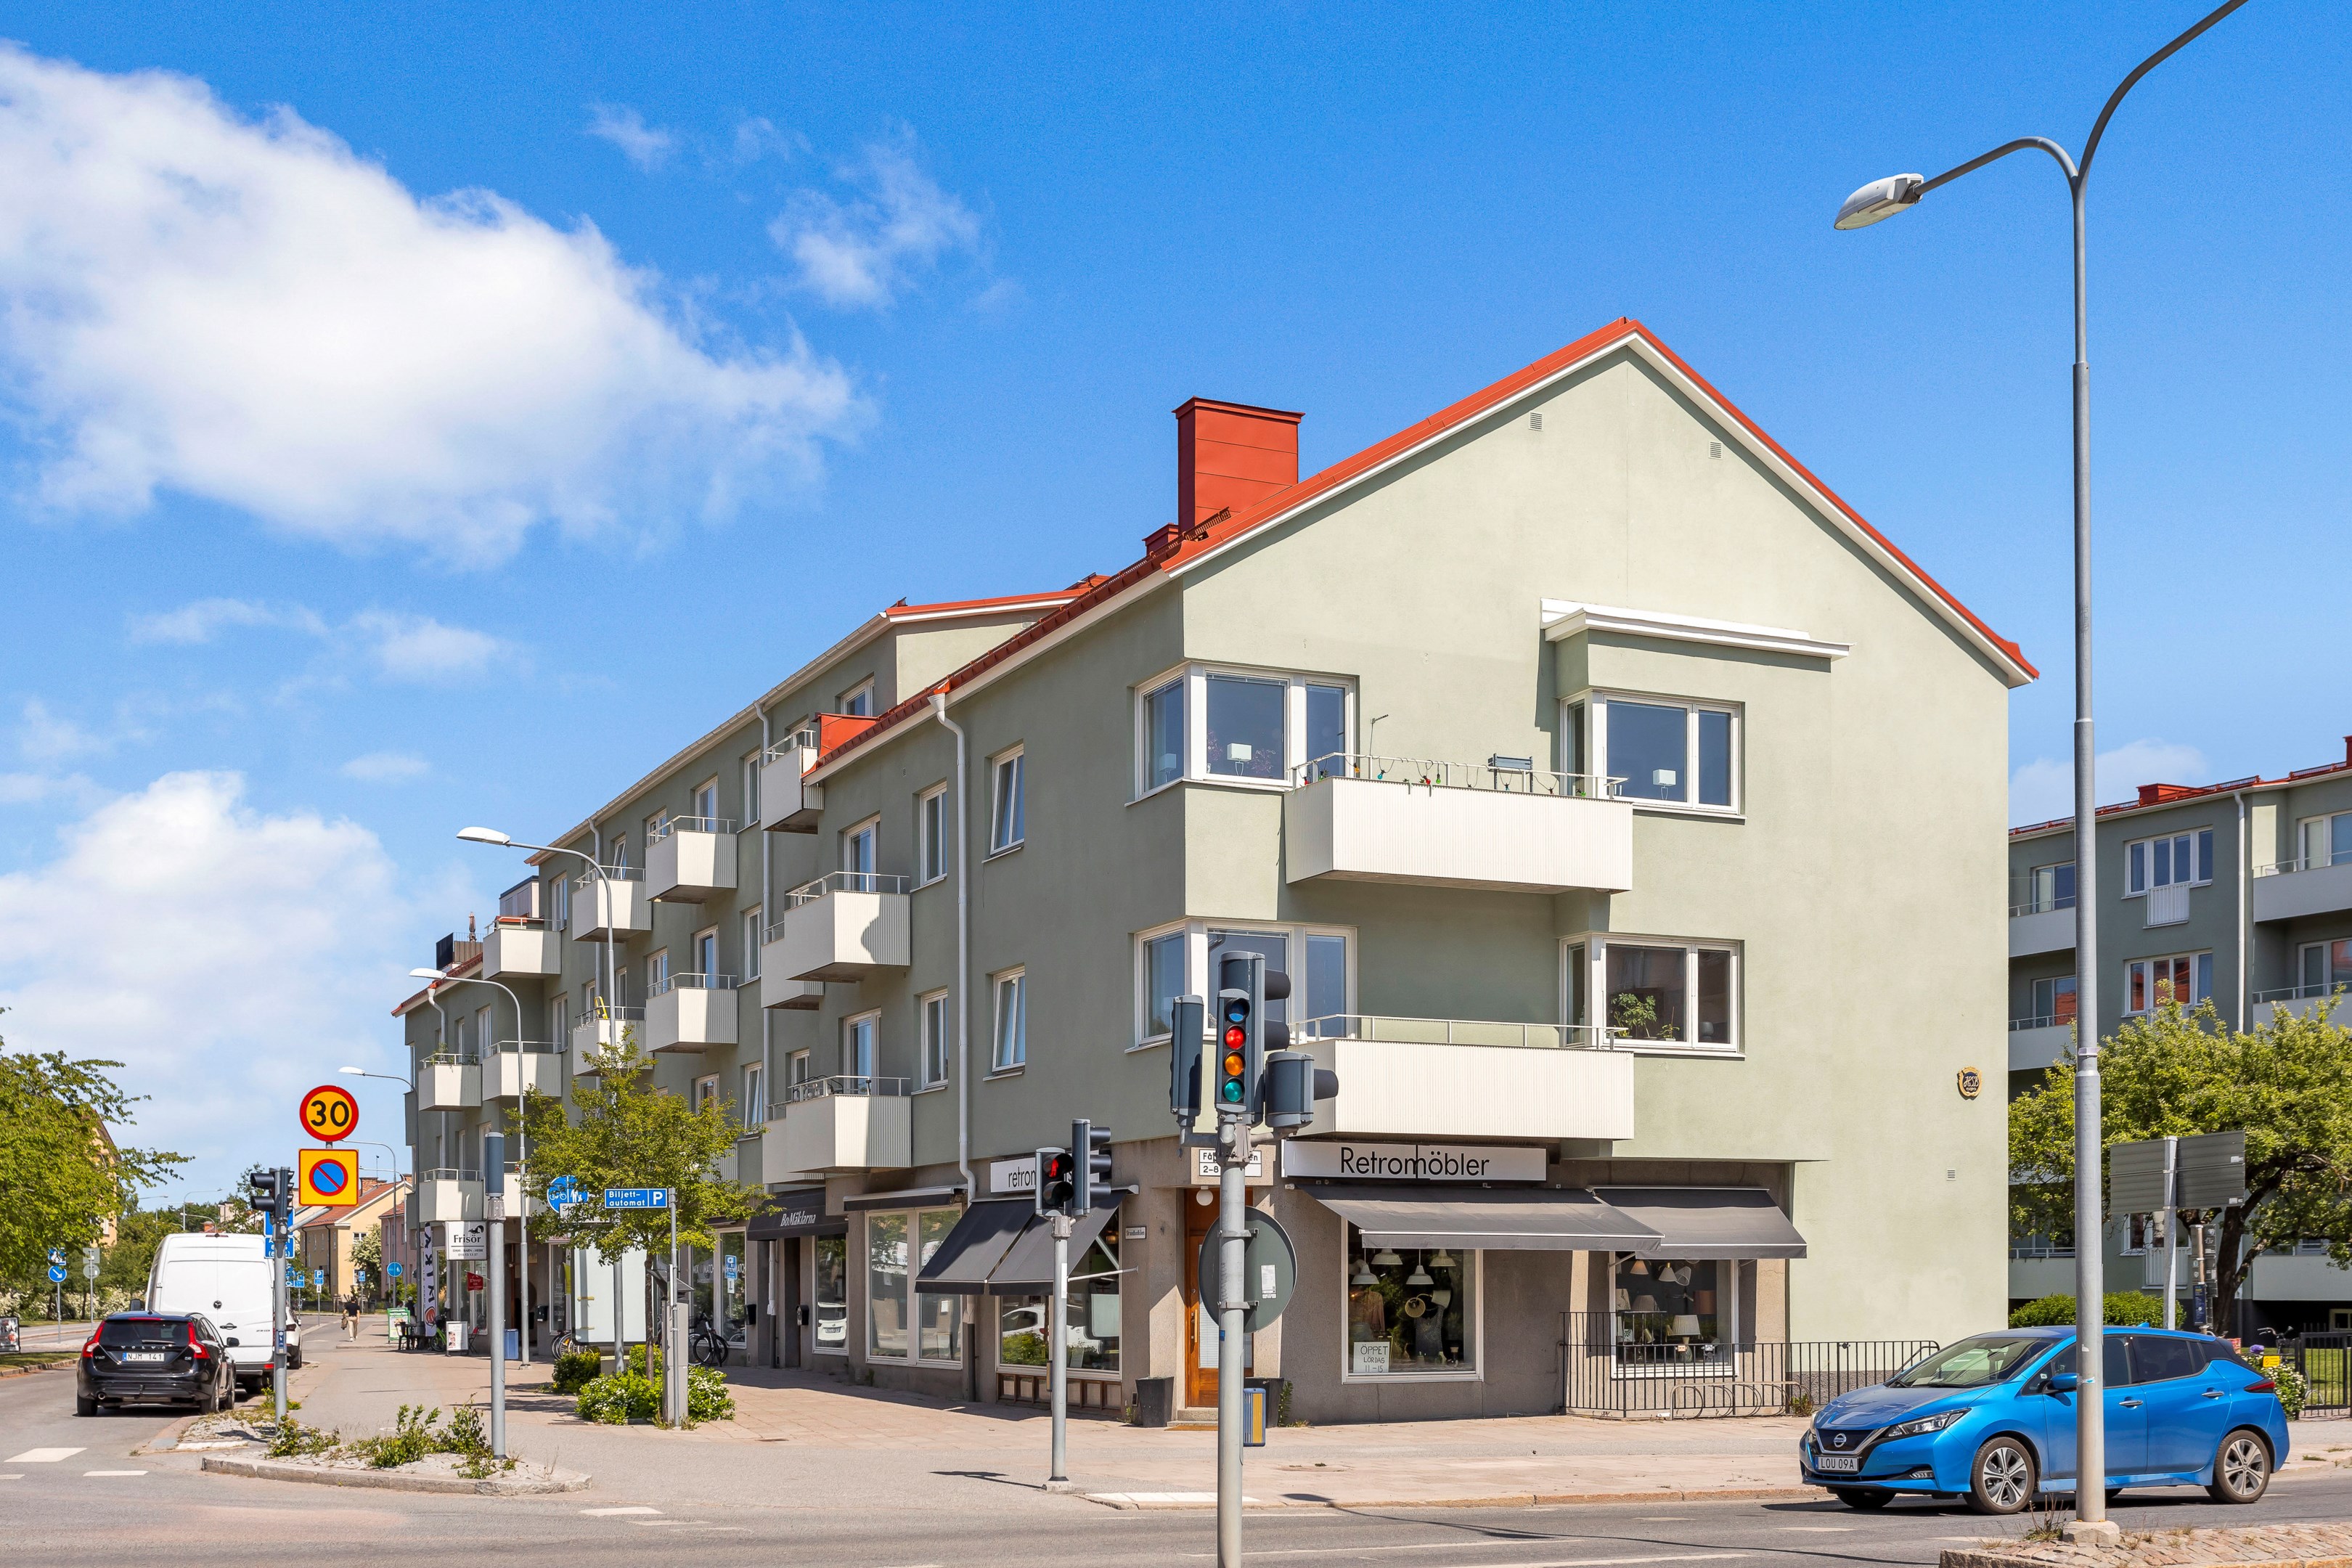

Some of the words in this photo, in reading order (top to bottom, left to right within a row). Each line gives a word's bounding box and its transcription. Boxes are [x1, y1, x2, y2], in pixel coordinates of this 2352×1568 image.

[1964, 1076, 1979, 1087] HSB
[311, 1100, 349, 1127] 30
[1341, 1146, 1490, 1175] Retromöbler
[609, 1191, 641, 1199] Biljett-
[653, 1191, 663, 1205] P
[780, 1210, 816, 1227] BoMäklarna
[454, 1234, 481, 1243] Frisör
[1360, 1344, 1388, 1355] ÖPPET
[1363, 1355, 1385, 1364] LÖRDAG
[1821, 1458, 1836, 1469] LOU
[1838, 1458, 1854, 1469] 09A
